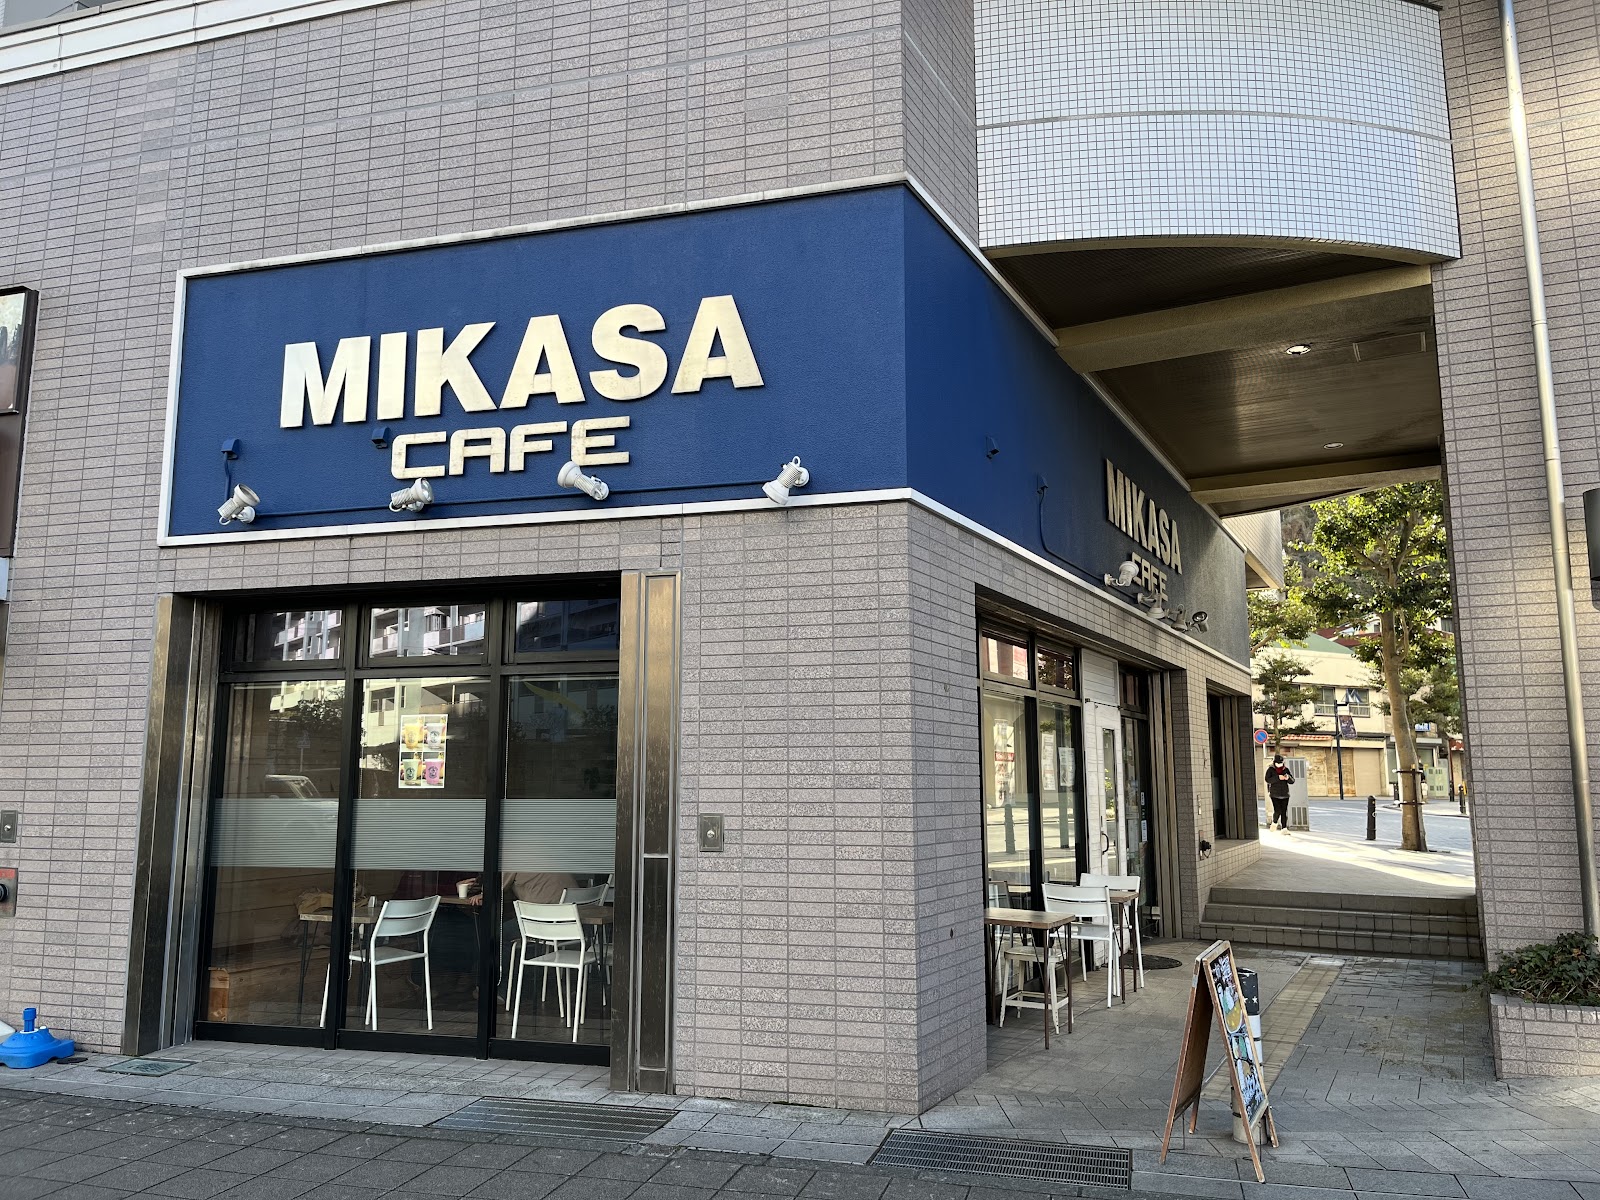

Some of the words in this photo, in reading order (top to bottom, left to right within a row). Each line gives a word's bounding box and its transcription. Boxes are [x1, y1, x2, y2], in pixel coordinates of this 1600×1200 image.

[279, 294, 765, 429] MIKASA
[390, 415, 631, 480] CAFE
[1105, 458, 1183, 575] MIKASA
